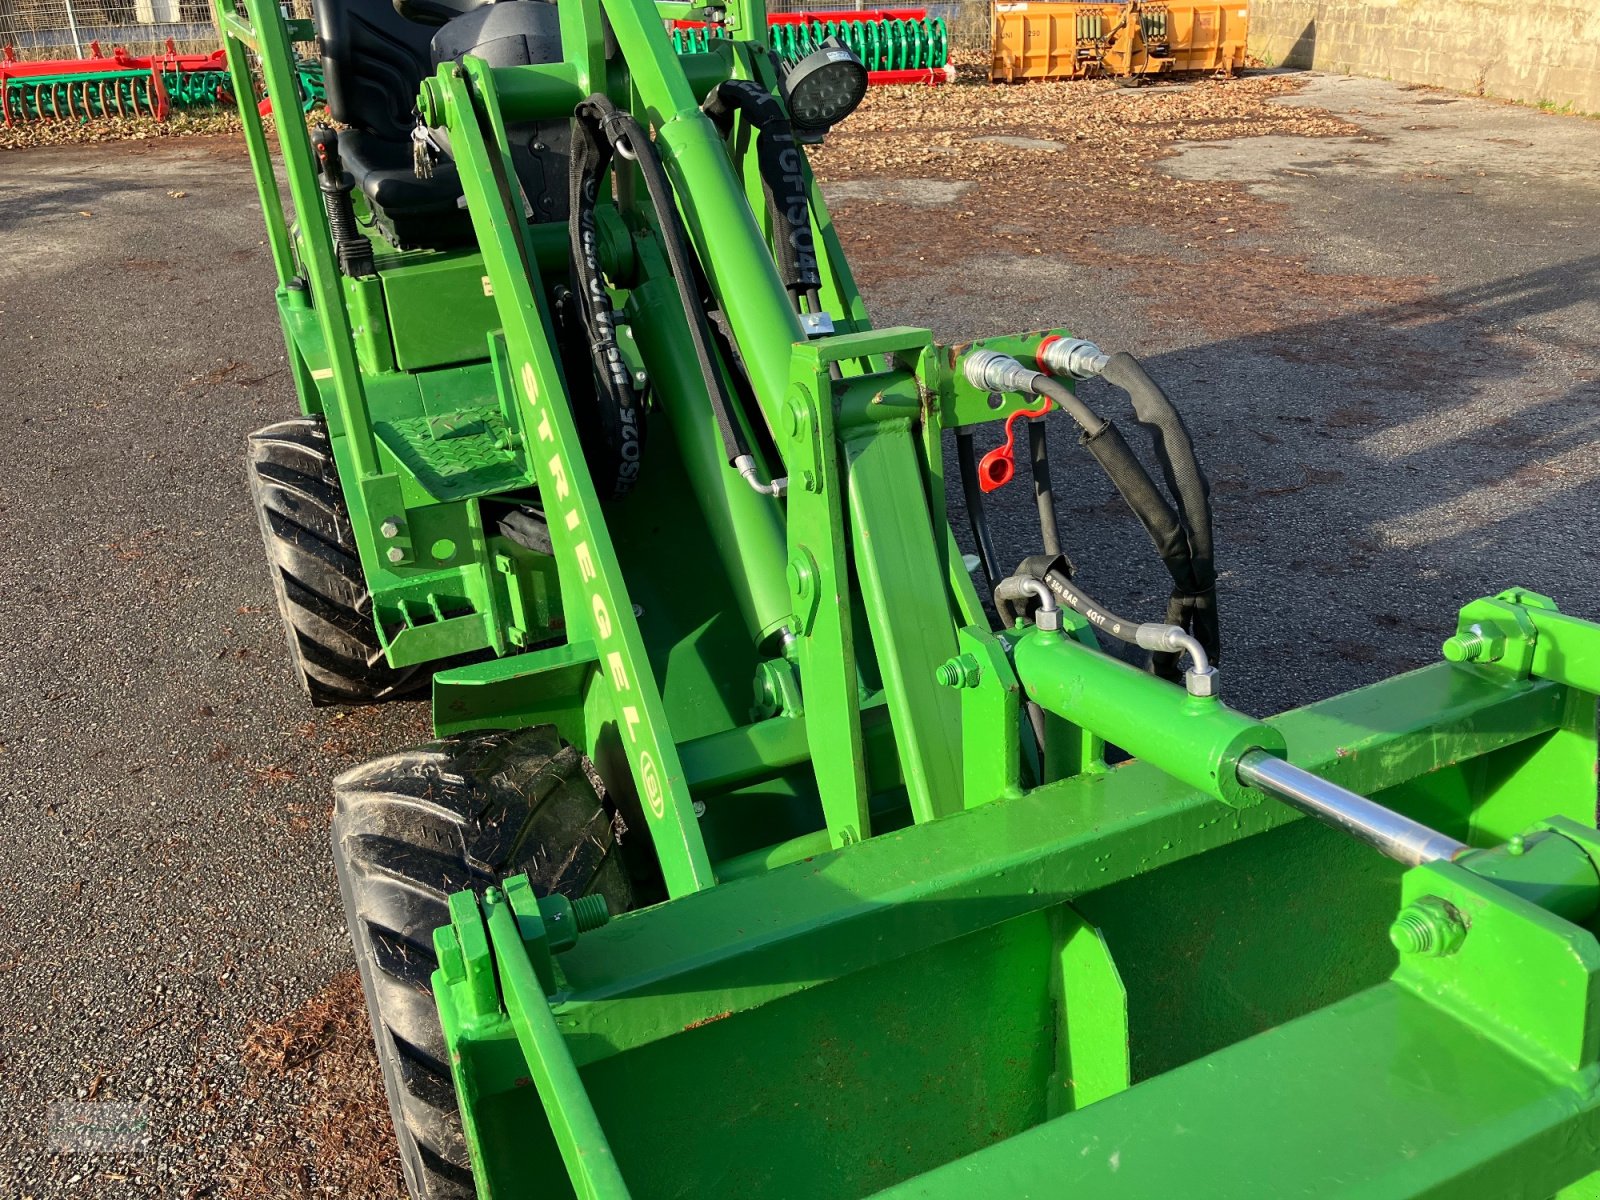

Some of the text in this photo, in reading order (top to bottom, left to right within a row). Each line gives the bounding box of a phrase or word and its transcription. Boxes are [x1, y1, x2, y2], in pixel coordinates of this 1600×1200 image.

[521, 361, 639, 743] STRIEGEL
[1063, 589, 1078, 606] BAR
[1086, 609, 1106, 625] 4Q17
